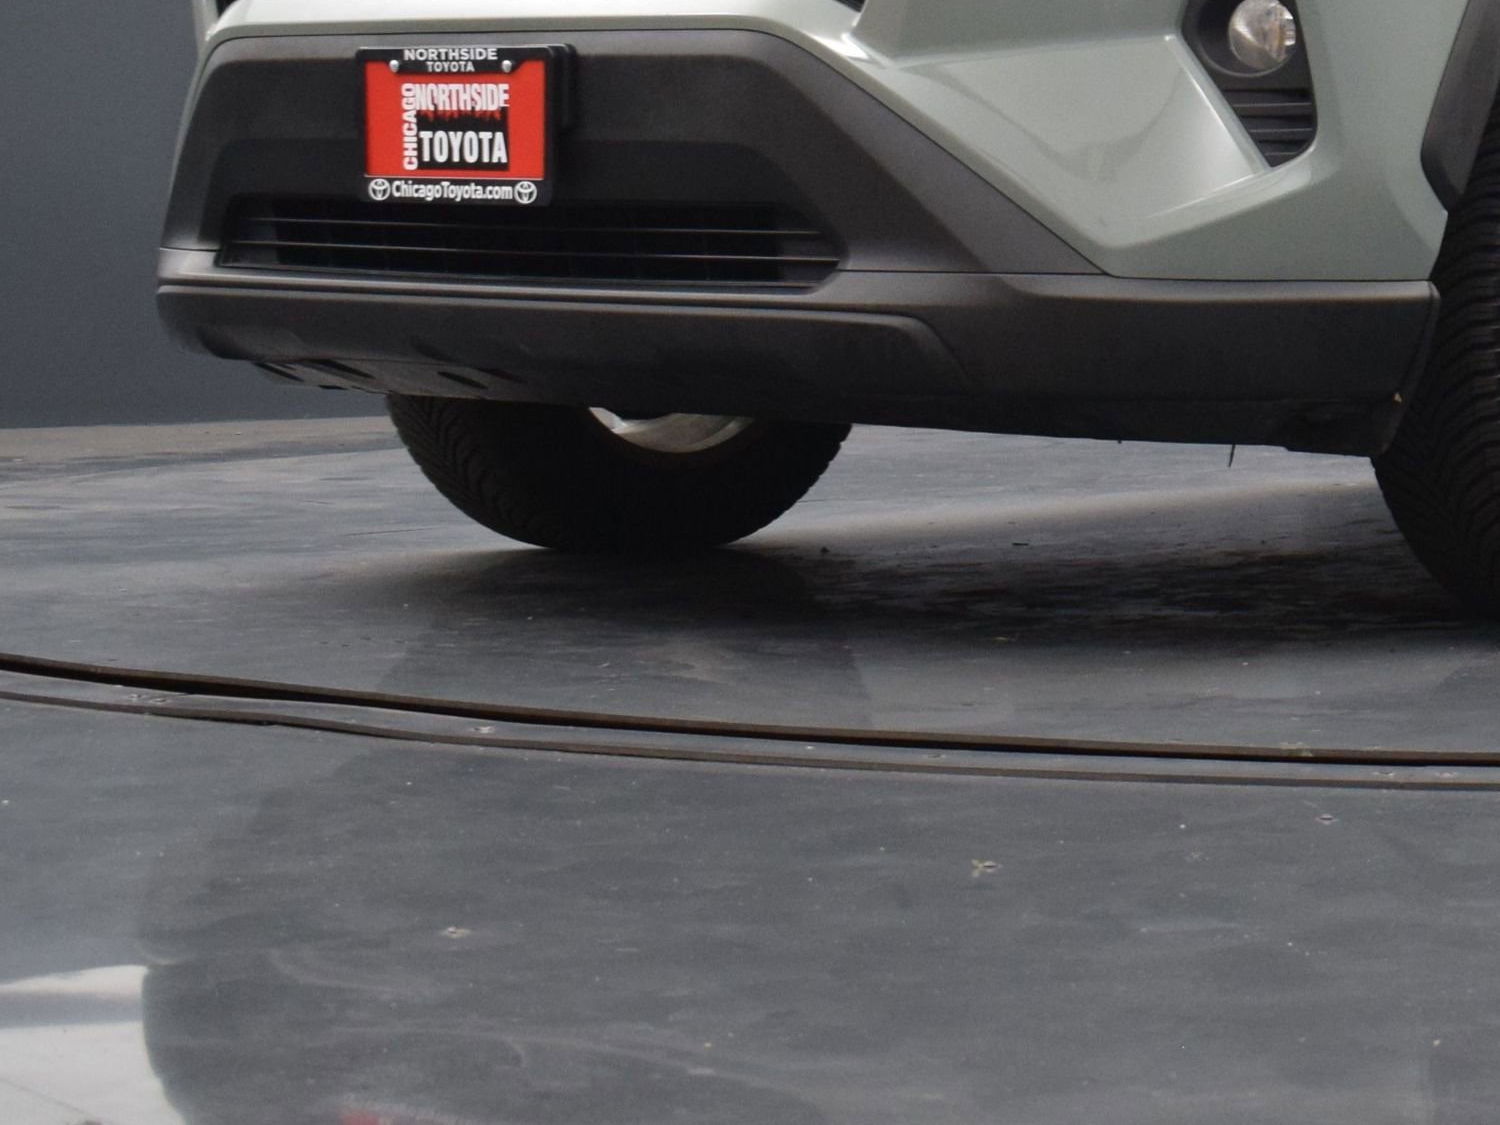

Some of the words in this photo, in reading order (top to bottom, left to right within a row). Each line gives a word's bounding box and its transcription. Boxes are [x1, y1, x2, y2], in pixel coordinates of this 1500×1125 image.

[403, 48, 498, 61] NORTHSIDE
[426, 61, 475, 72] TOYOTA
[415, 83, 510, 111] NORTHSIDE
[401, 82, 418, 170] CHICAGO
[419, 131, 508, 163] TOYOTA
[391, 180, 513, 201] ChicagoToyota.com
